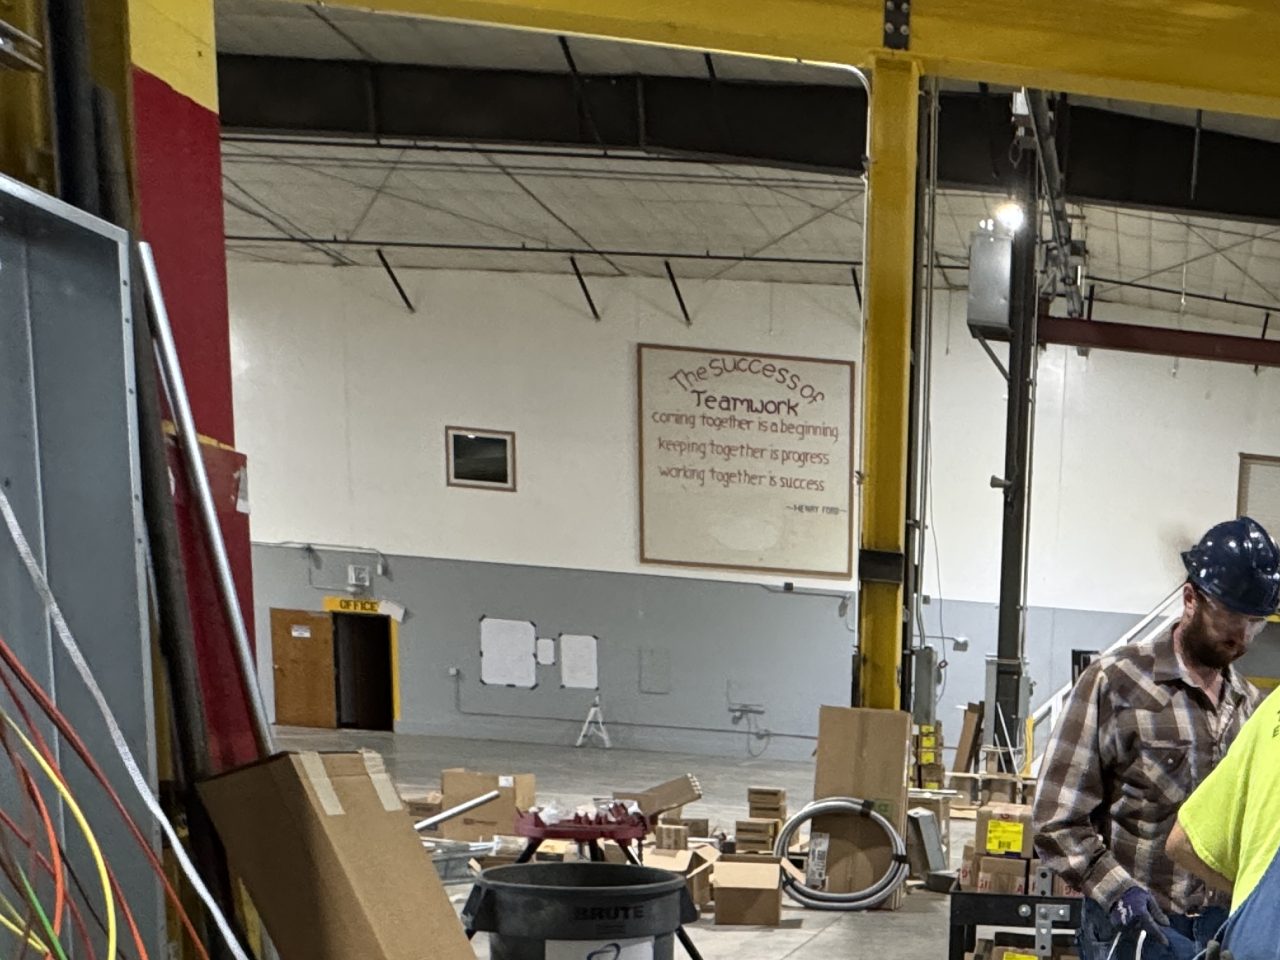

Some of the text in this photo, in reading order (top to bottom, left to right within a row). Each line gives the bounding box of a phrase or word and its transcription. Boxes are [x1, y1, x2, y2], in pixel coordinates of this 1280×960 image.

[670, 366, 708, 391] The
[690, 389, 800, 416] Teamwork
[652, 409, 839, 443] coming together is a beginning
[658, 436, 830, 467] keeping together is progress
[658, 465, 705, 487] working
[709, 467, 767, 488] together
[779, 476, 825, 491] success
[339, 599, 378, 612] OFFICE
[575, 904, 645, 919] BRUTE
